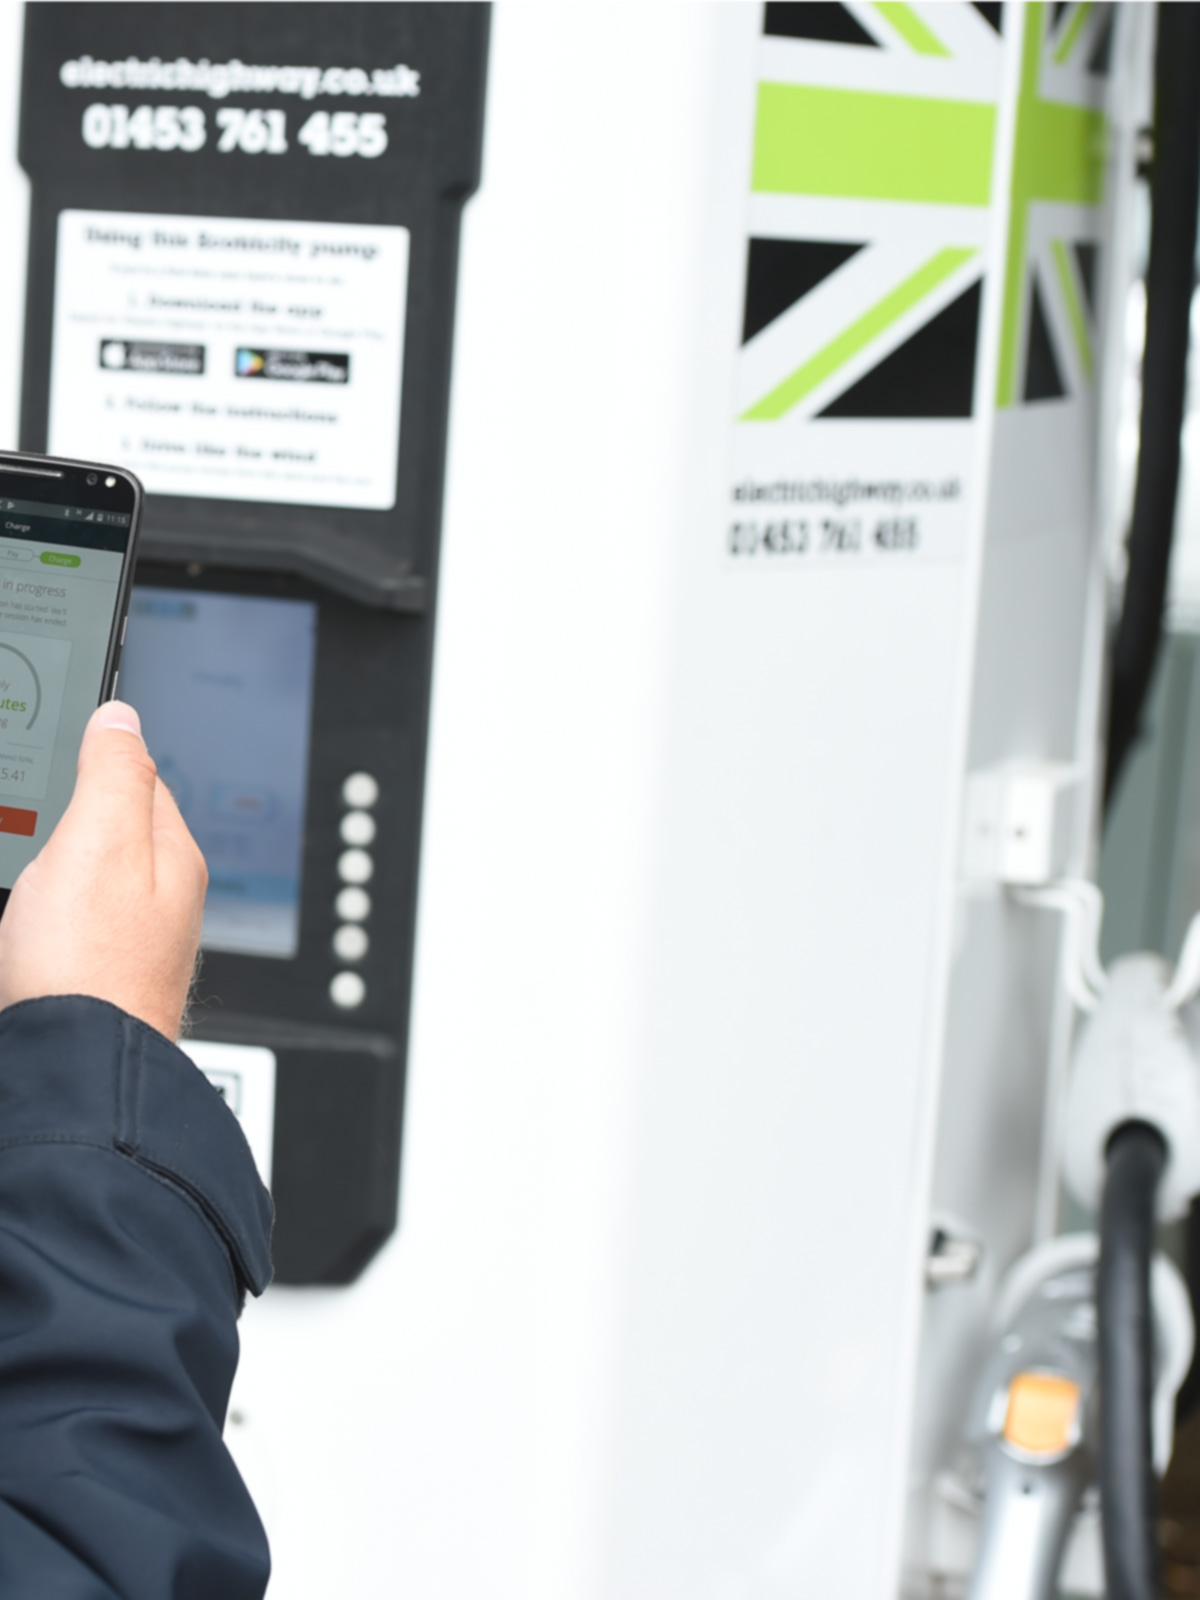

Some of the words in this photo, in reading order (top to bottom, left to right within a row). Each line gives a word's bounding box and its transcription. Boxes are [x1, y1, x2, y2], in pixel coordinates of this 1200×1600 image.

[60, 55, 420, 99] electrichighway.co.uk
[82, 103, 207, 152] 01453
[216, 107, 288, 154] 761
[297, 111, 389, 158] 455
[5, 521, 31, 533] Charge
[7, 550, 20, 560] Pay
[48, 555, 73, 566] Charge
[2, 577, 14, 591] in
[16, 581, 67, 598] progress
[10, 600, 23, 610] has
[4, 612, 30, 622] session
[30, 615, 43, 625] has
